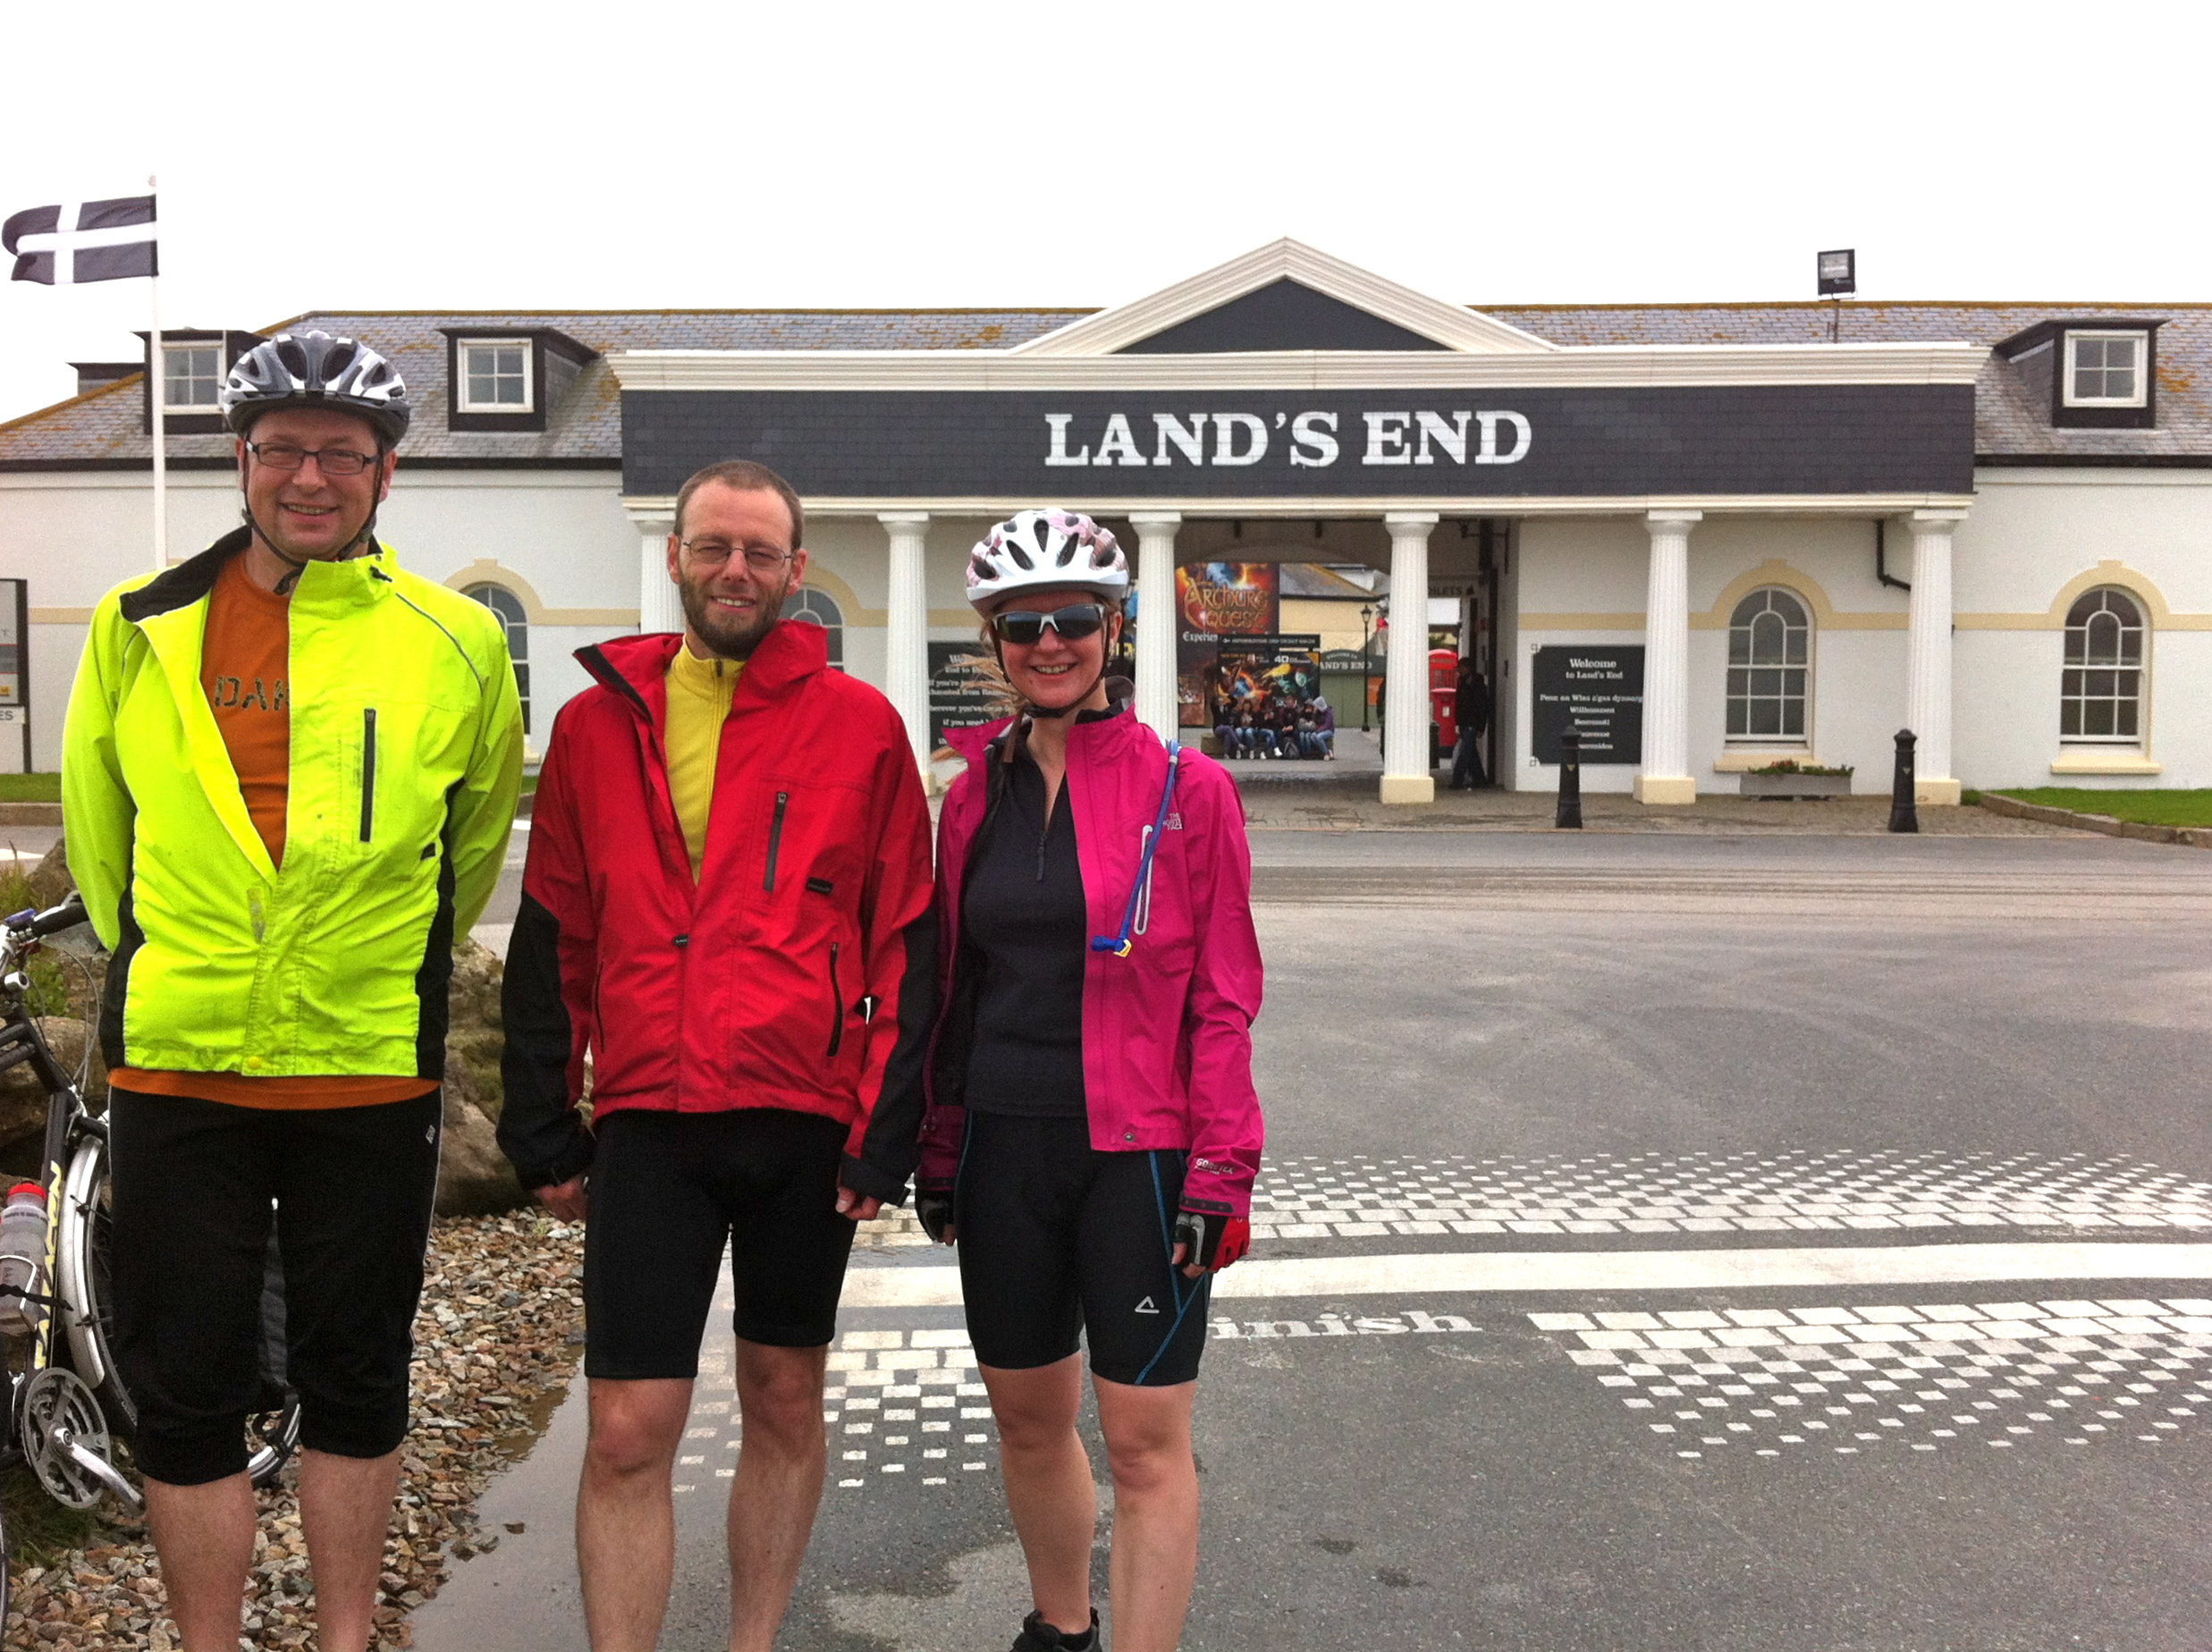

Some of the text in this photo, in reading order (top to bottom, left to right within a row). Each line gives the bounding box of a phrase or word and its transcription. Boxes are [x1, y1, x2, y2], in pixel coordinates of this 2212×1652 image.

[1044, 410, 1532, 468] LAND'S END
[1428, 586, 1463, 595] OILETS
[1182, 629, 1219, 643] Experien
[1320, 661, 1373, 670] AND'S END
[1569, 658, 1617, 668] Welcome
[1566, 670, 1624, 679] to Land's End
[214, 677, 290, 712] DAK
[1208, 1311, 1484, 1340] inish
